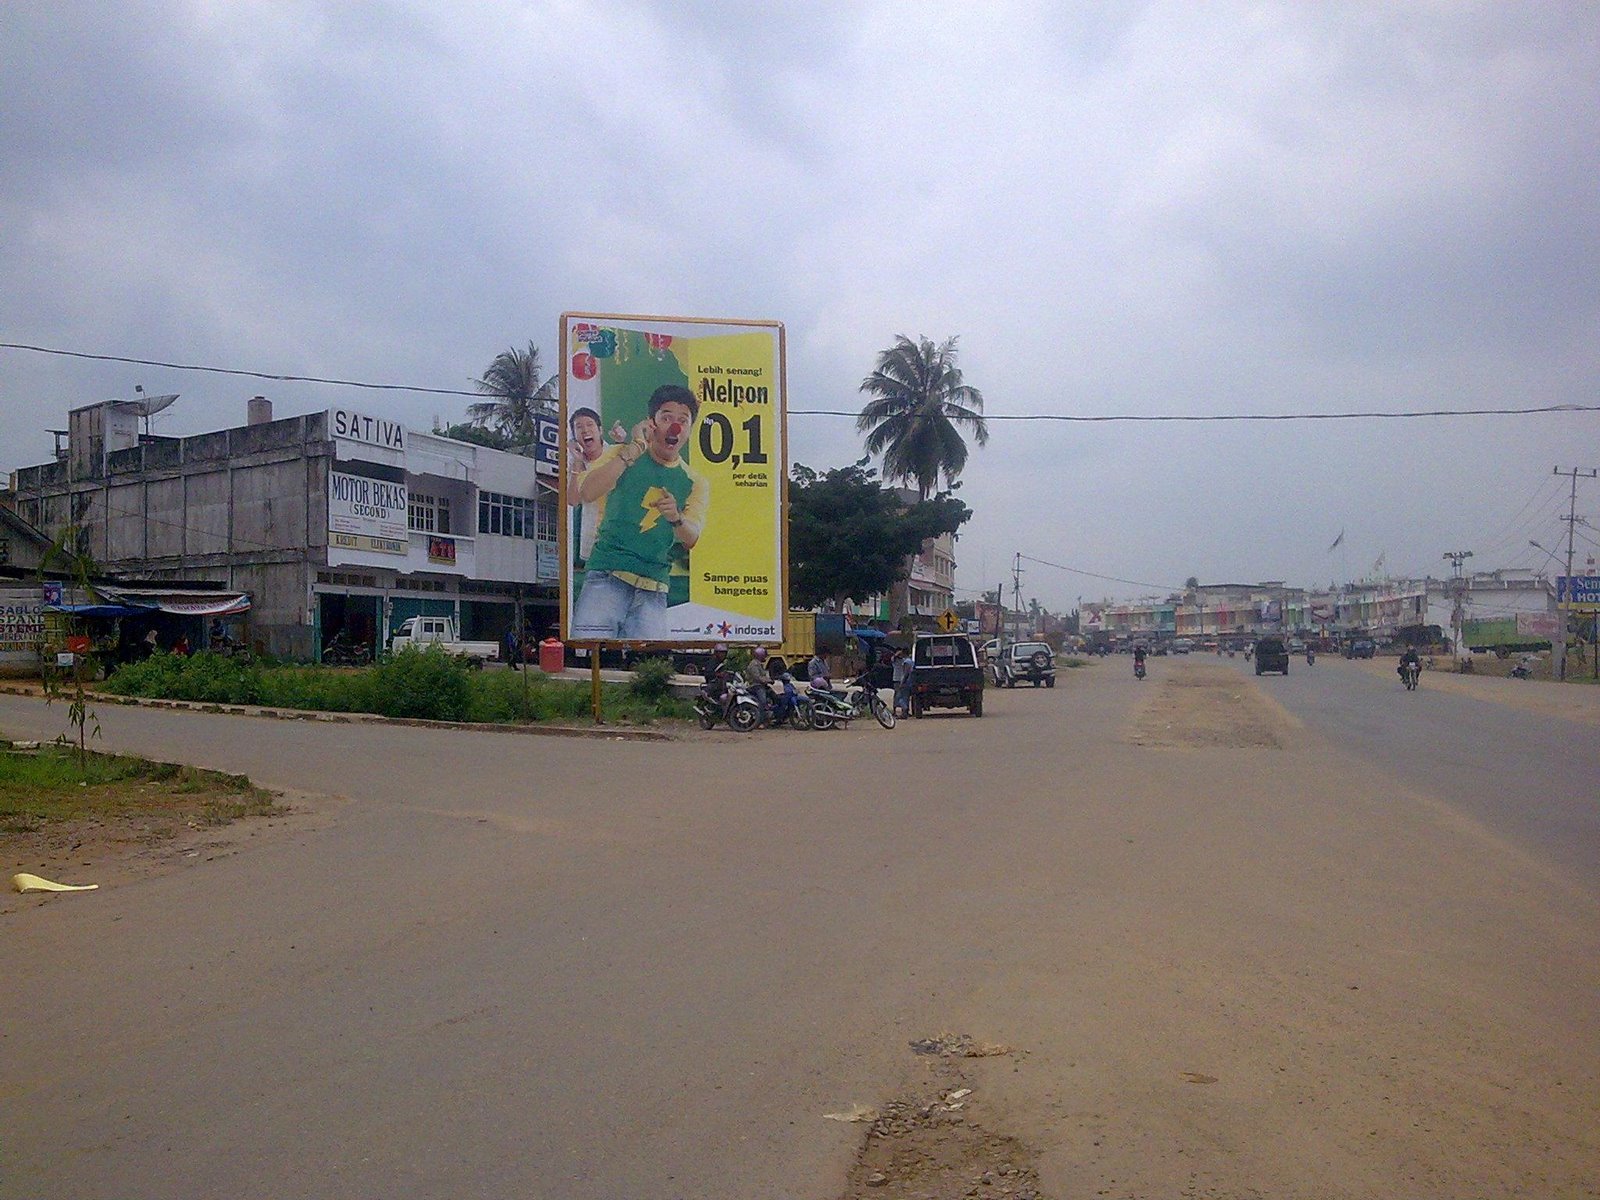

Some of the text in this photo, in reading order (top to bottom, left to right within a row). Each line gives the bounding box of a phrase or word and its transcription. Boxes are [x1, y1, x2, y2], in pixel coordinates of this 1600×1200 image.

[697, 365, 762, 377] Lebih senang!
[702, 377, 768, 407] Nelpon
[335, 410, 403, 449] SATIVA
[699, 412, 768, 471] 0,1
[747, 472, 768, 480] detik
[735, 480, 768, 488] seharian
[332, 474, 406, 511] MOTOR BEKAS
[703, 572, 769, 584] Sampe puas
[714, 585, 769, 597] bangeetss
[735, 624, 776, 635] indosat
